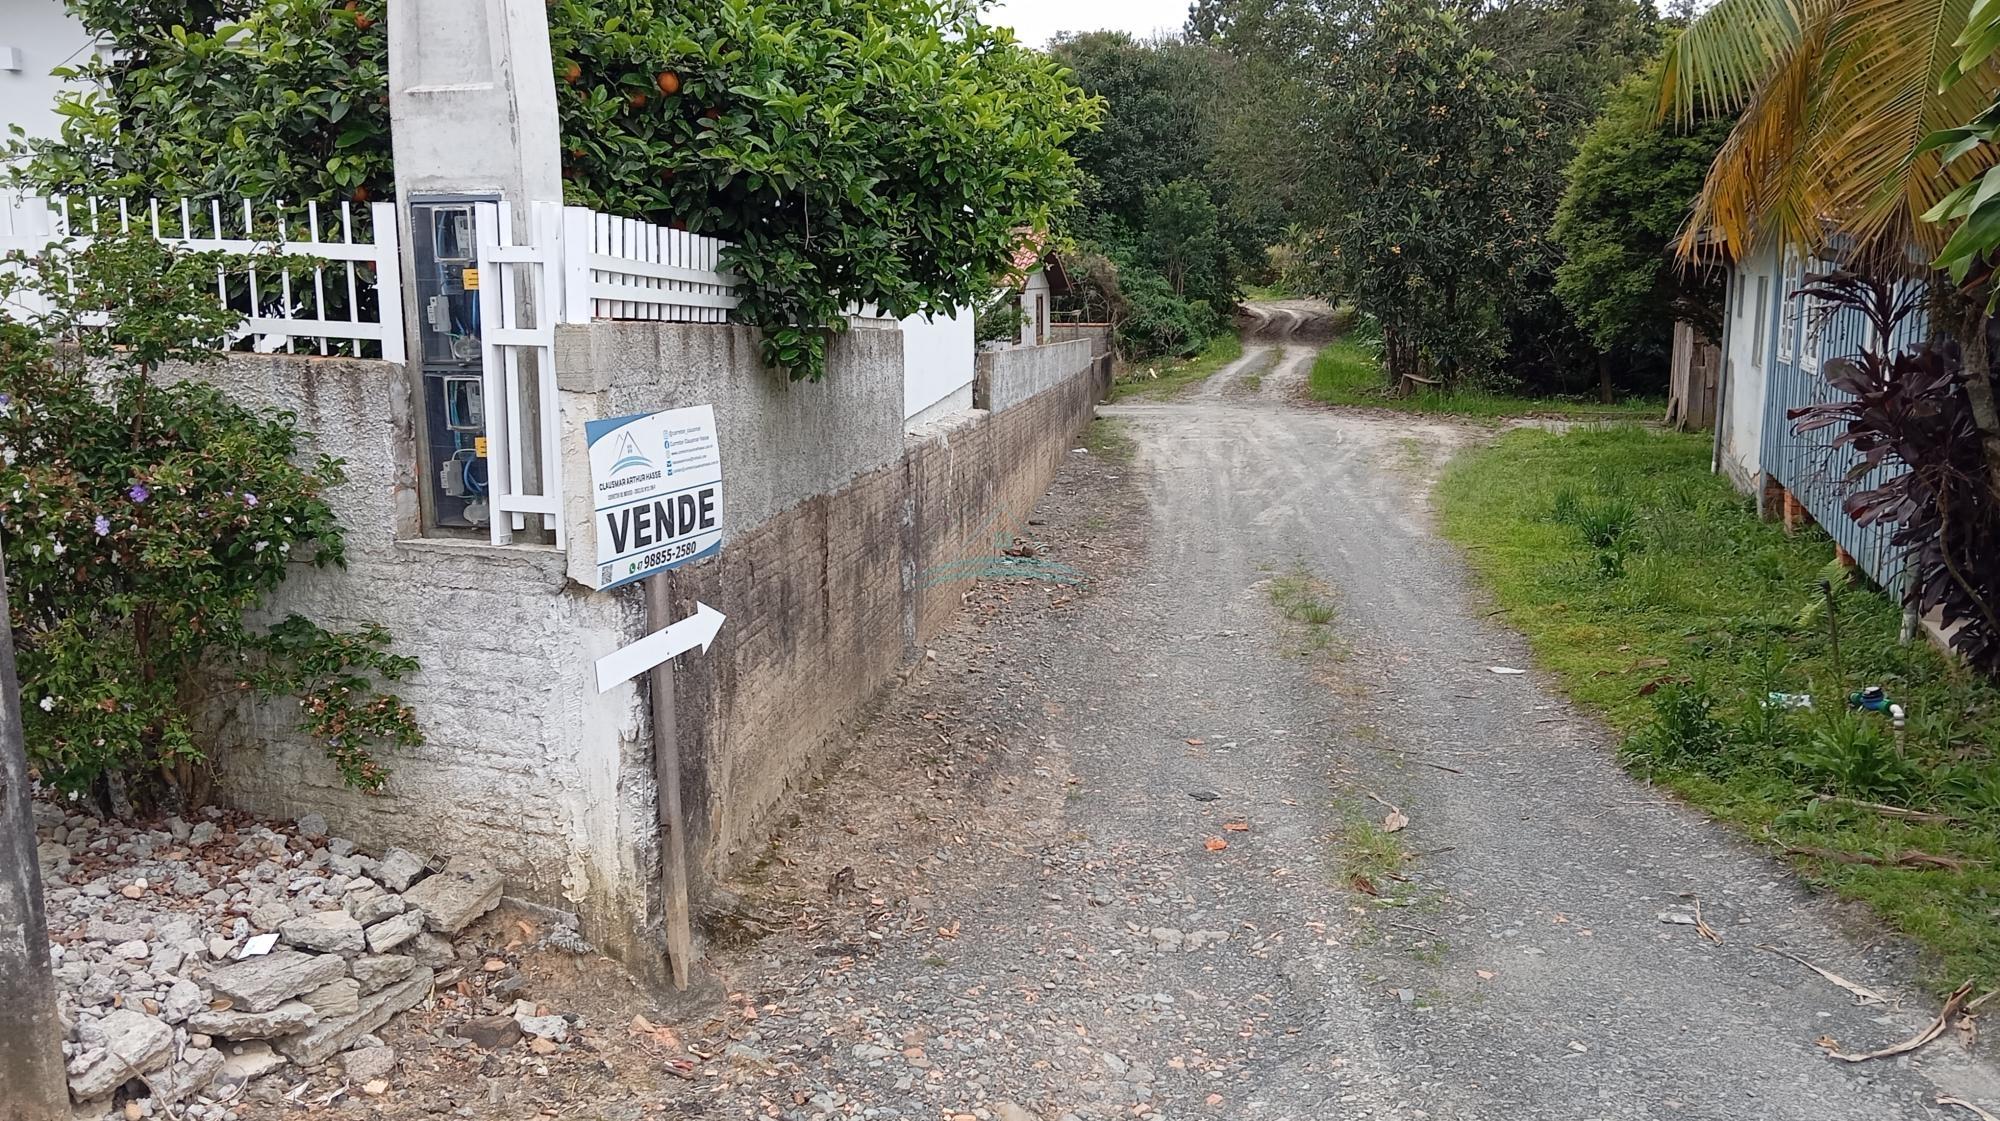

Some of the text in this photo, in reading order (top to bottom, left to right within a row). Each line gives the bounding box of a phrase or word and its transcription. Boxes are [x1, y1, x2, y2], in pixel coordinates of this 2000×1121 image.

[599, 470, 662, 491] CLAUSMAR ARTHUR HASSE
[607, 488, 715, 554] VENDE
[644, 541, 697, 569] 98855-2580
